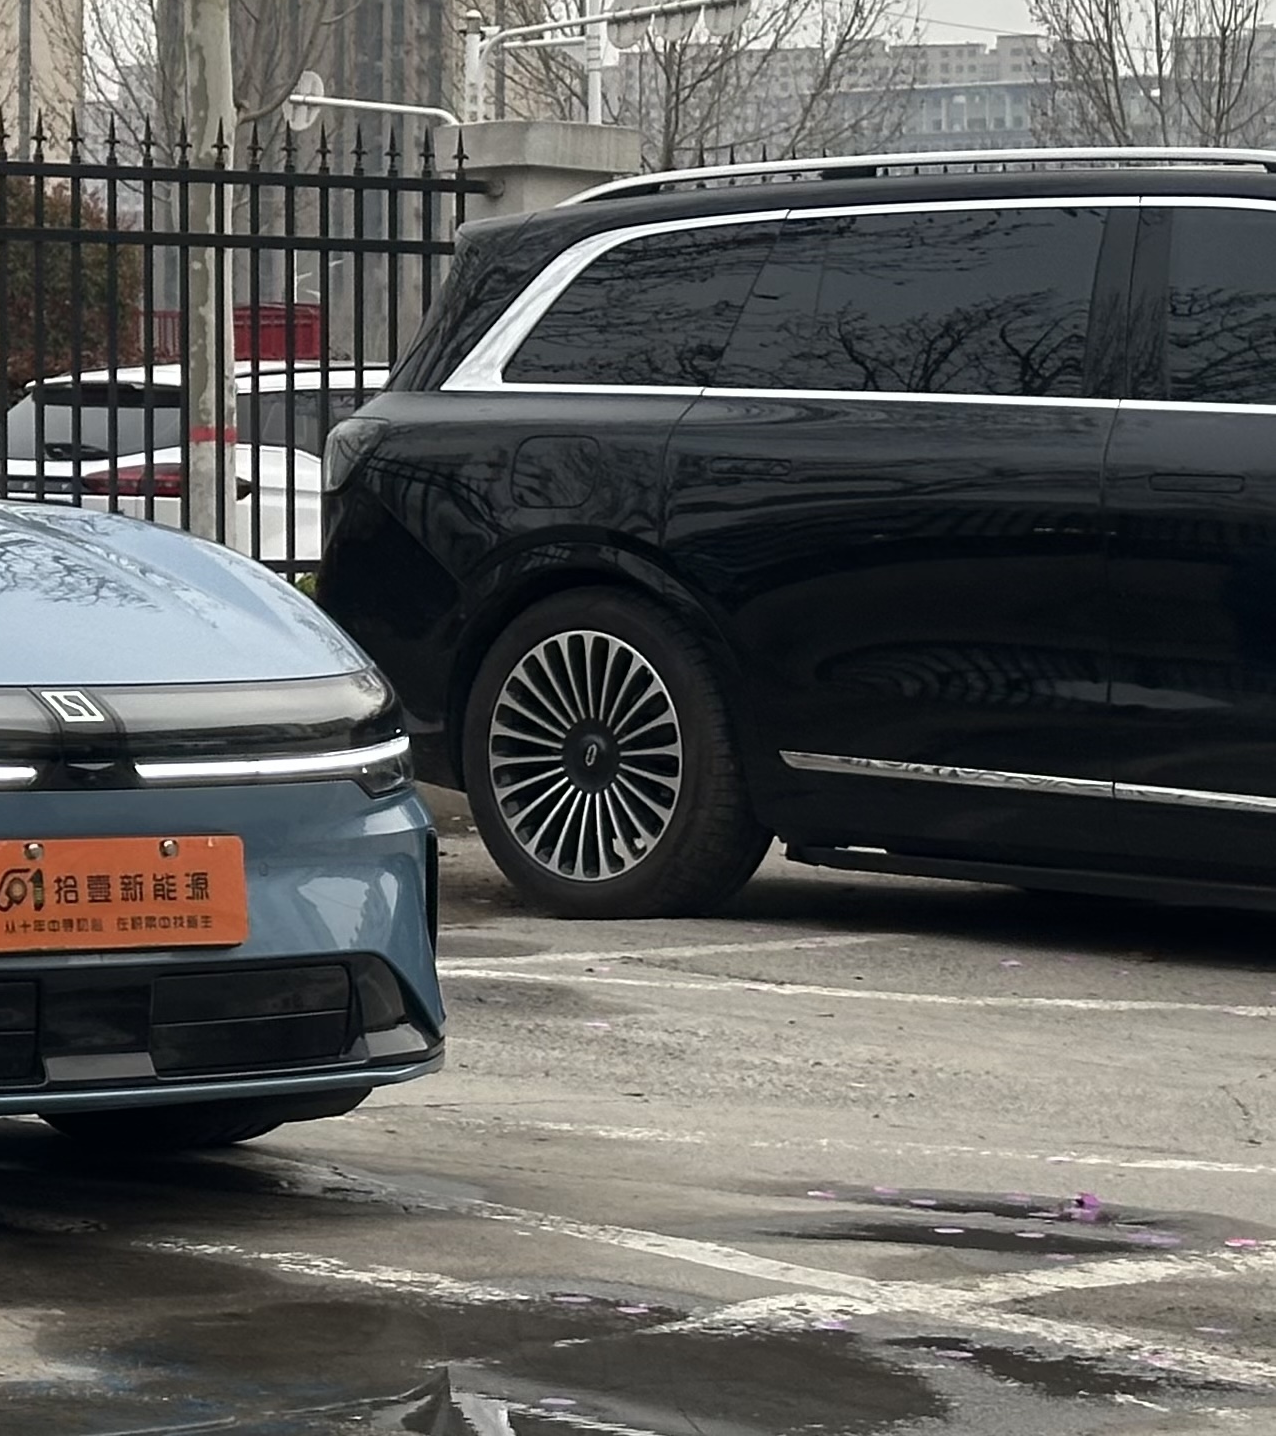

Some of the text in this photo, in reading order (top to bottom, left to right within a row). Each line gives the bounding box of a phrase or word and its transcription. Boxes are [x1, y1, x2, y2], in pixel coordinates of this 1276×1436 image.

[53, 871, 210, 904] 拾壹新能源
